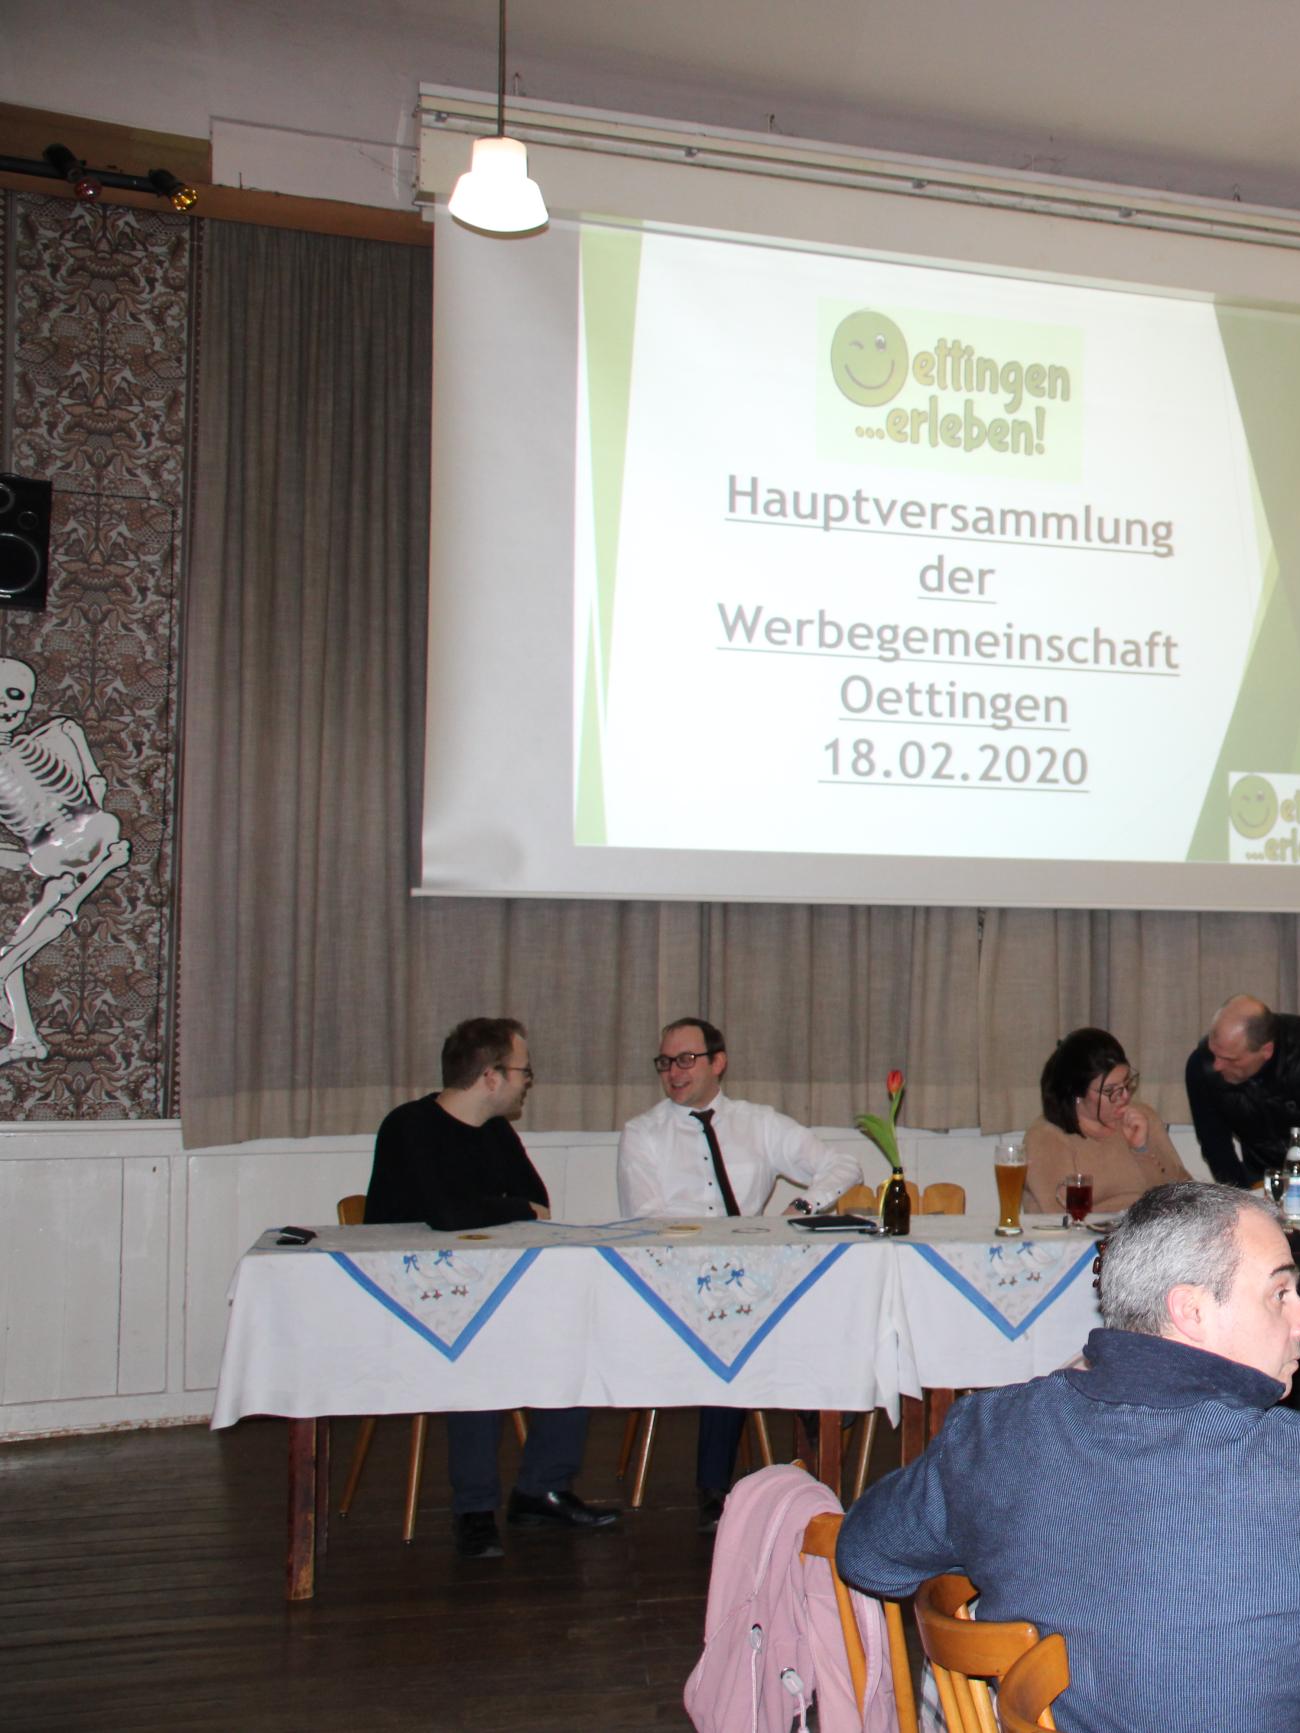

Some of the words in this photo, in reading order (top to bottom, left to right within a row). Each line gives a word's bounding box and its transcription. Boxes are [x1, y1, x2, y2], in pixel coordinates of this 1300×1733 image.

[728, 474, 1174, 558] Hauptversammlung
[919, 554, 996, 596] der
[717, 602, 1180, 670] Werbegemeinschaft
[840, 675, 1069, 731] Oettingen
[824, 737, 1090, 786] 18.02.2020
